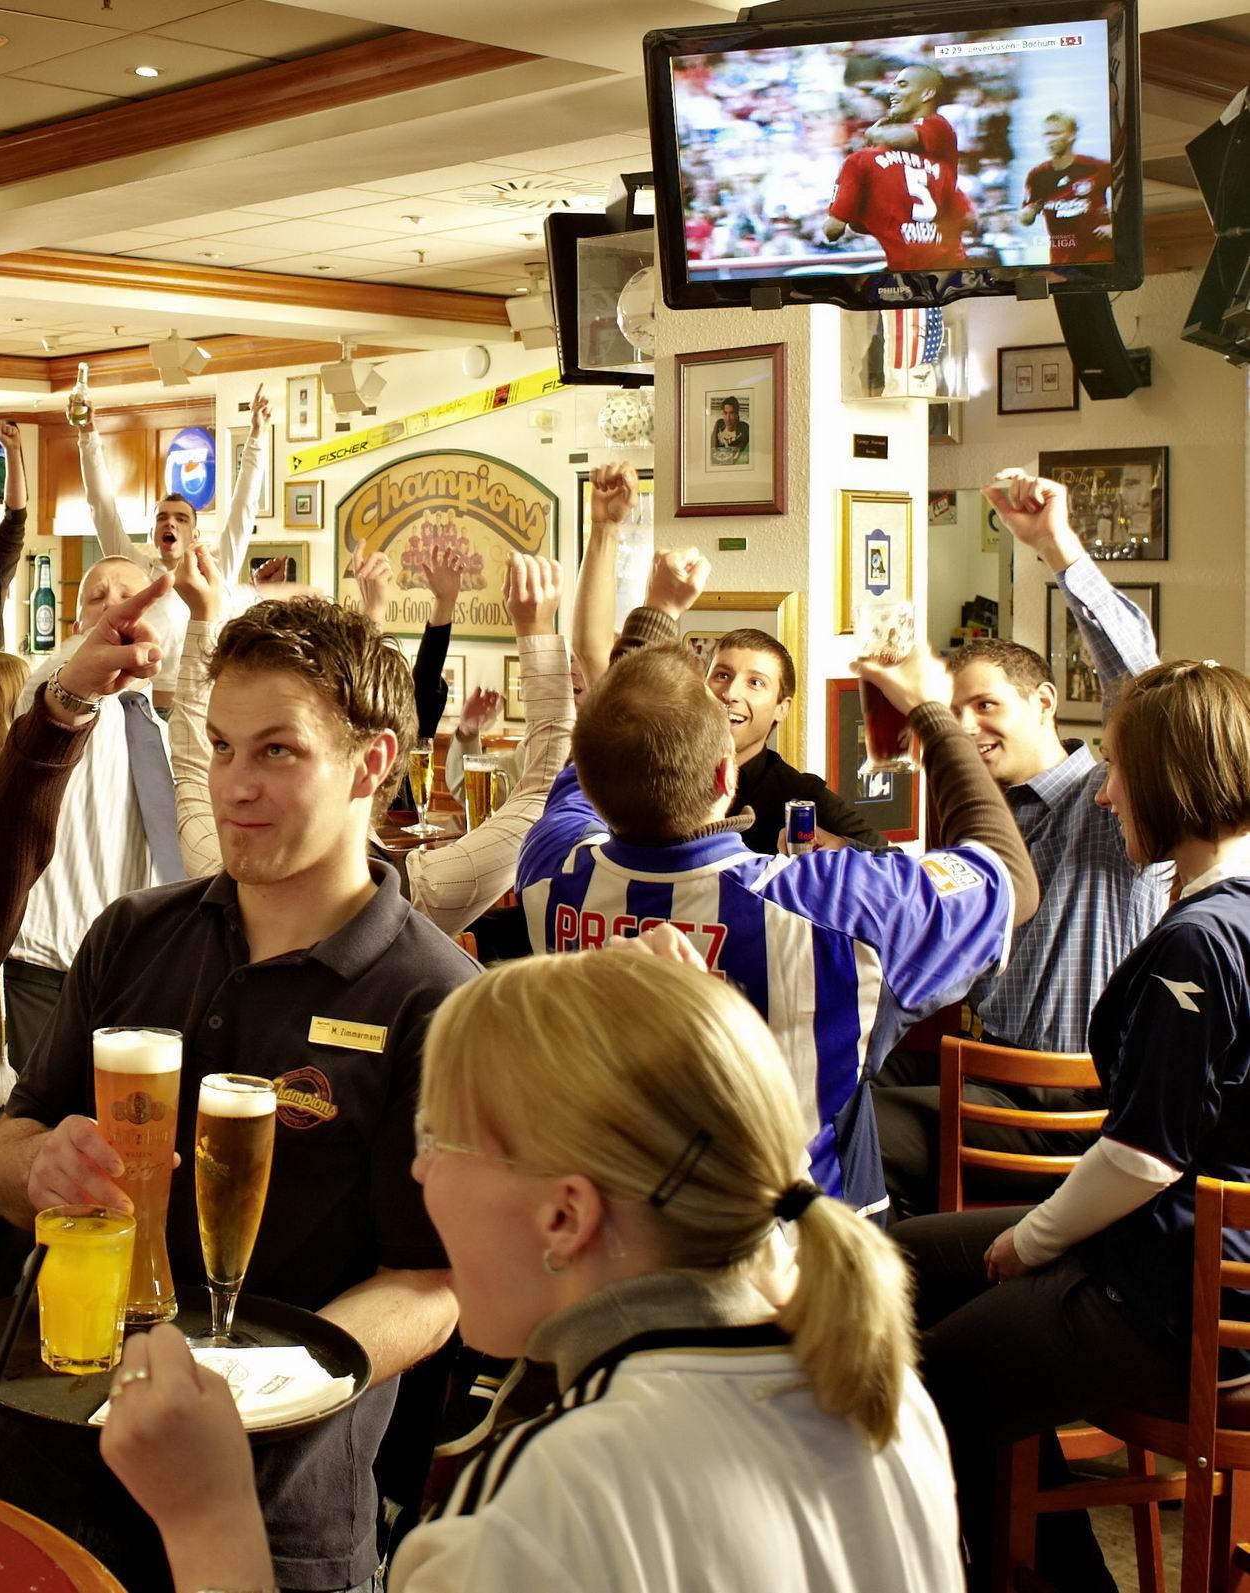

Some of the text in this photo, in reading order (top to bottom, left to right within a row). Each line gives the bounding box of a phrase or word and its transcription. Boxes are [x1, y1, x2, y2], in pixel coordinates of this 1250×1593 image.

[1022, 39, 1056, 48] Bochum
[904, 165, 938, 222] 5
[318, 441, 368, 465] FISCHER
[345, 463, 547, 552] Champions
[470, 596, 500, 626] GOOD
[340, 1028, 381, 1042] Zimmermann
